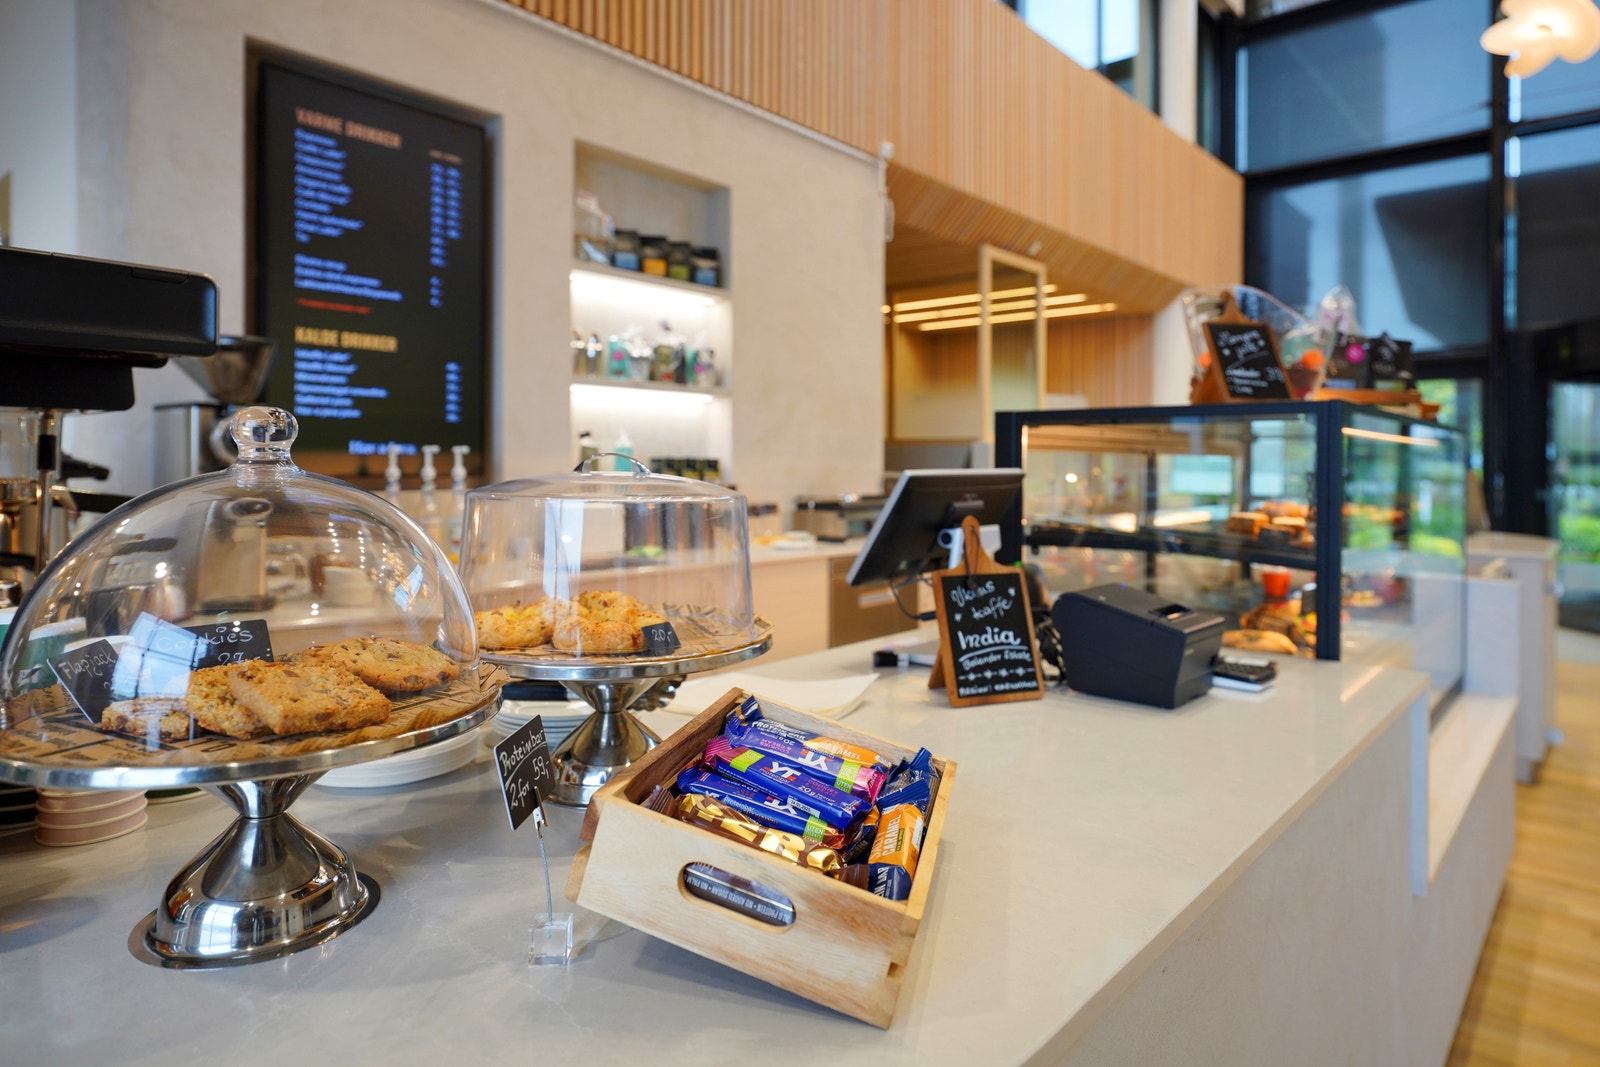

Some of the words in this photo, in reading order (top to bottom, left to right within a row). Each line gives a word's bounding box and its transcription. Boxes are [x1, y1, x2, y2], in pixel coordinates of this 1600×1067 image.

[156, 626, 253, 652] Cookies
[957, 625, 1021, 650] India
[58, 647, 116, 680] Flapjack
[500, 730, 543, 776] Proteinbar
[771, 762, 801, 779] YT
[510, 783, 519, 810] 2
[518, 778, 530, 807] for
[797, 785, 811, 793] 20
[723, 796, 755, 812] Proteinbar
[806, 824, 824, 836] UTEN
[882, 814, 901, 856] CARAMEL
[711, 886, 729, 898] SUGAR
[728, 893, 745, 905] ADDED
[757, 902, 778, 918] PROTEIN
